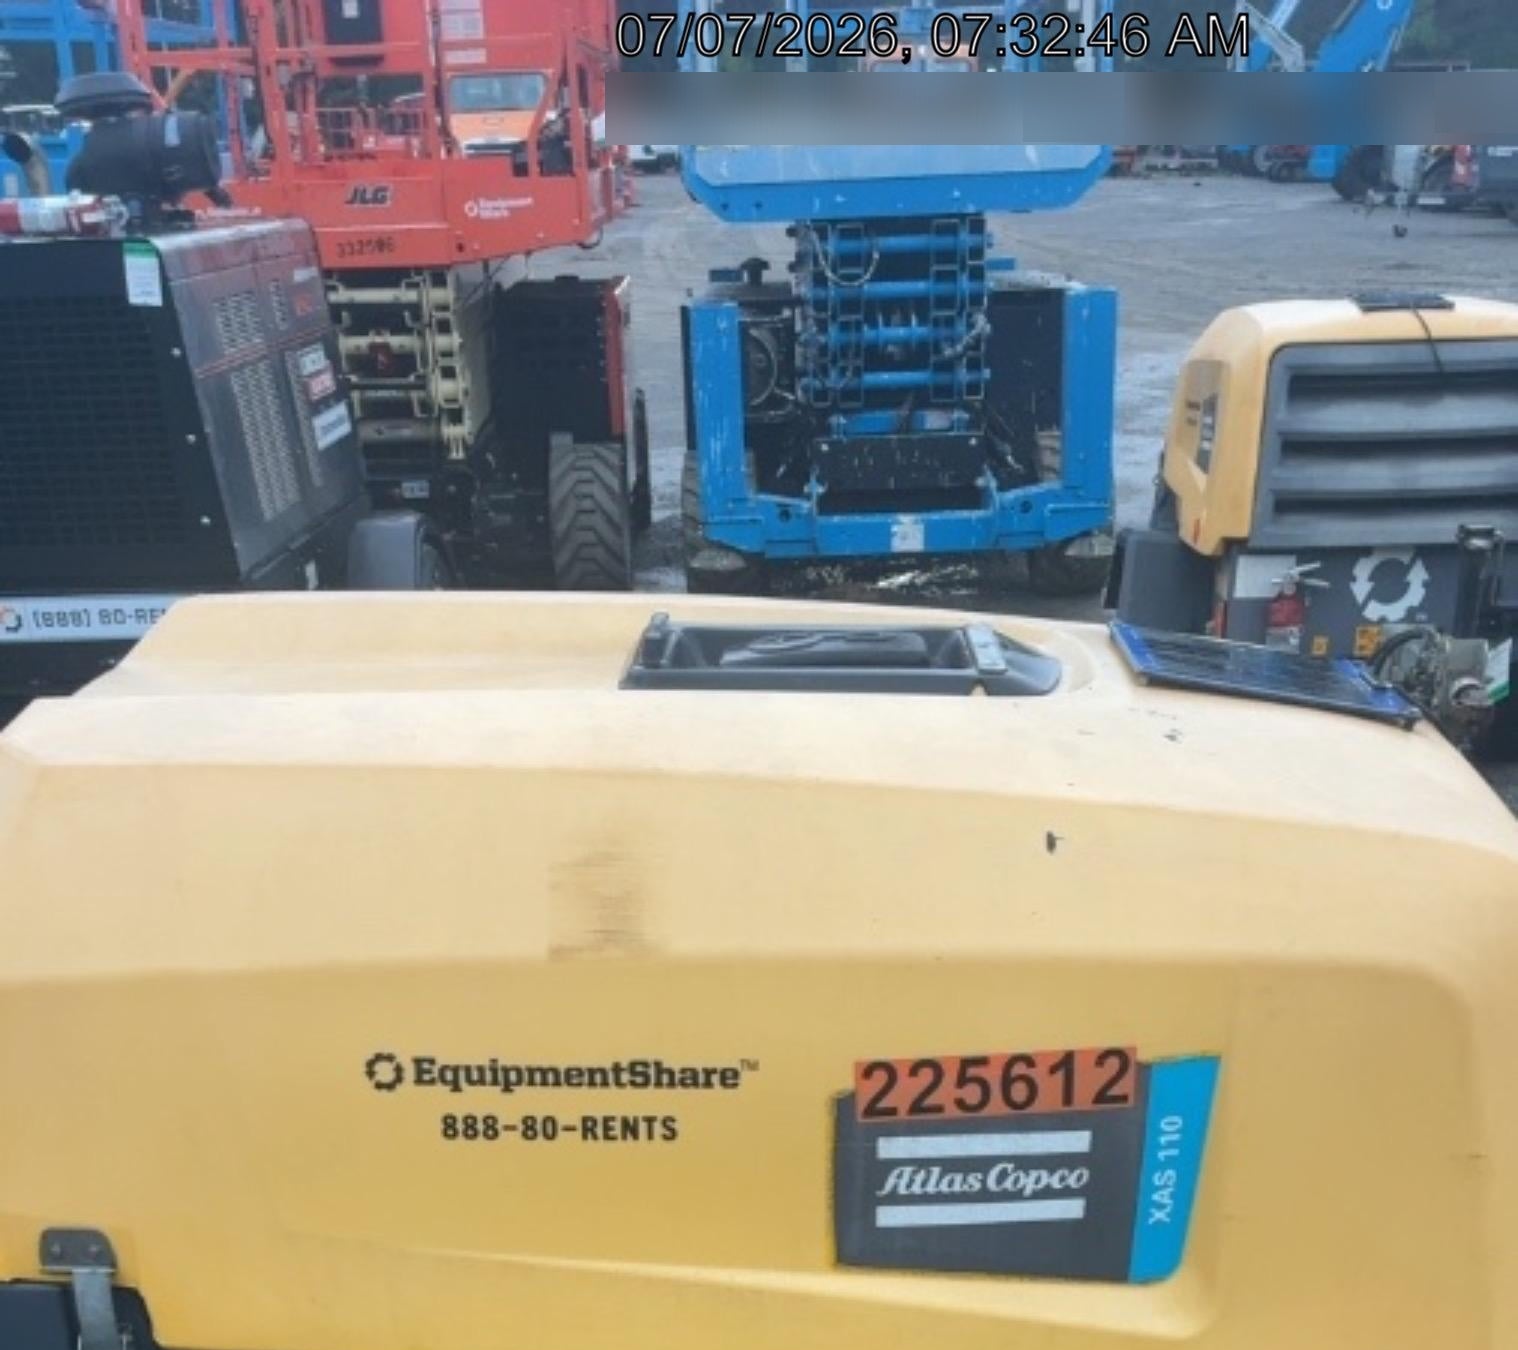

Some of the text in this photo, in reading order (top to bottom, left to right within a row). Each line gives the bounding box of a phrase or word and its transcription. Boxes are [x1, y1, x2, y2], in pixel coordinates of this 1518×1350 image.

[345, 185, 390, 205] JLG
[99, 608, 166, 625] 80-RE
[861, 1049, 1132, 1117] 225612
[441, 1115, 679, 1141] 888-80-RENTS
[876, 1163, 1090, 1197] Atlas Copco
[1149, 1116, 1183, 1224] XAS 110
